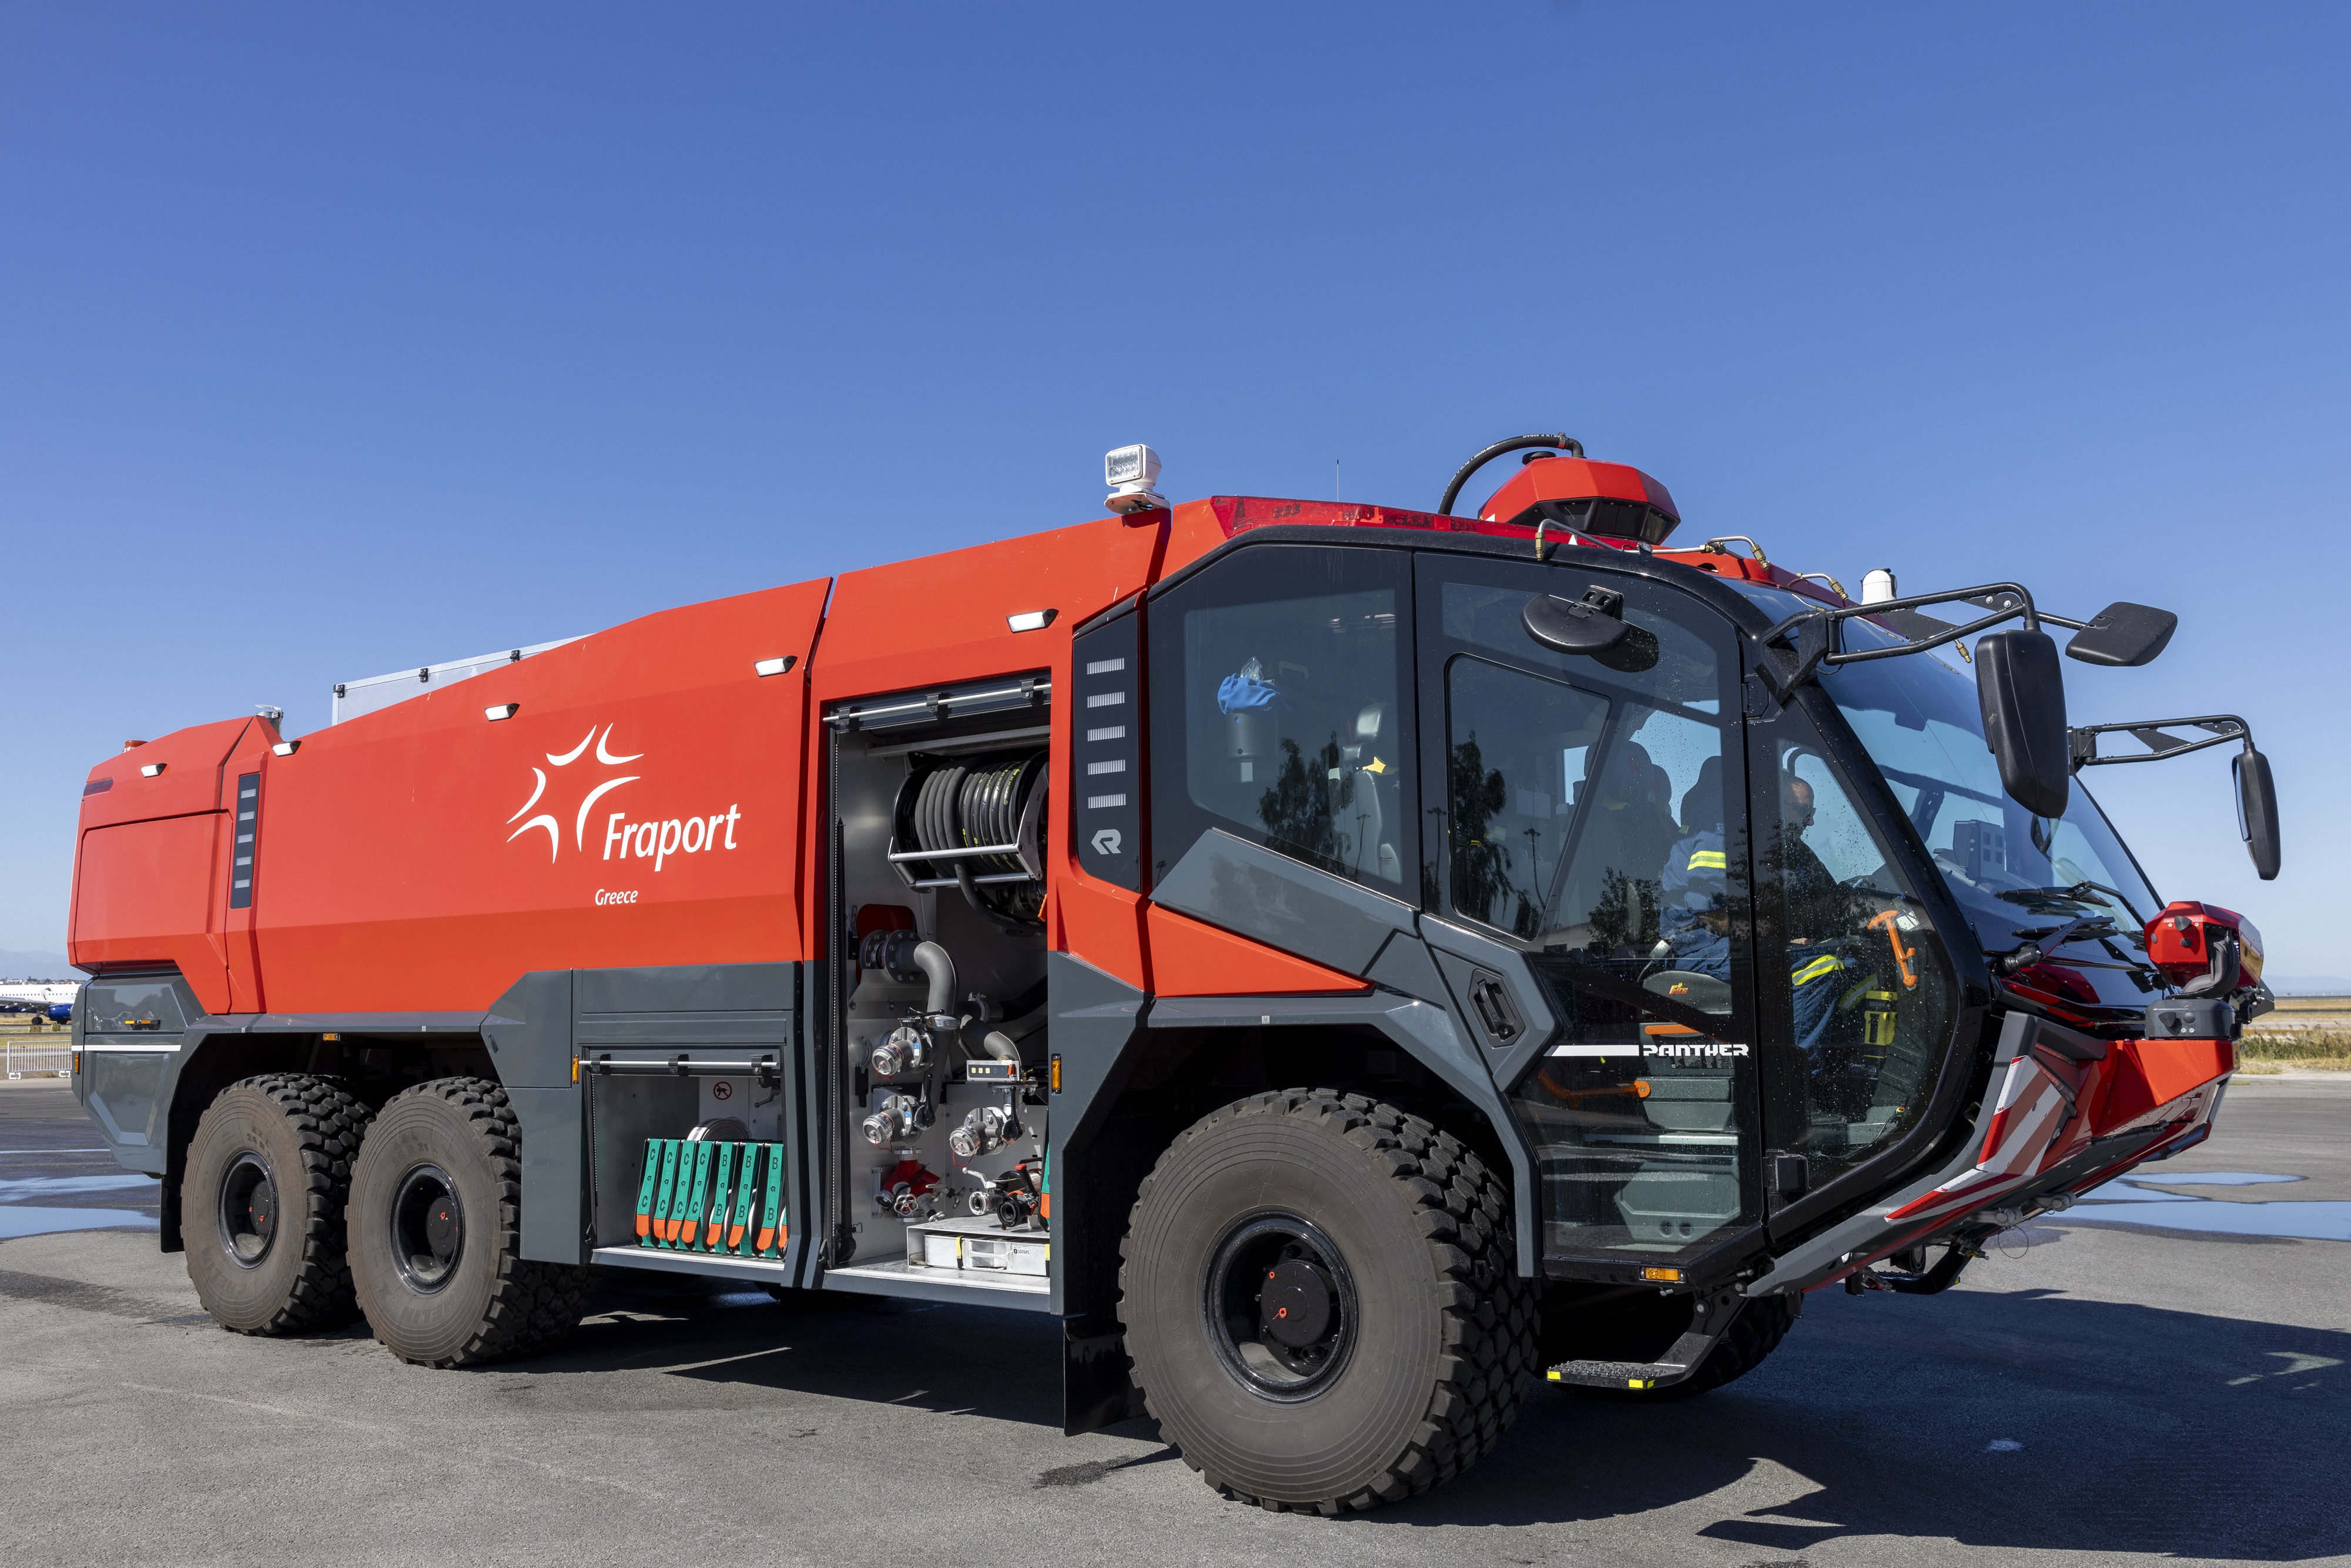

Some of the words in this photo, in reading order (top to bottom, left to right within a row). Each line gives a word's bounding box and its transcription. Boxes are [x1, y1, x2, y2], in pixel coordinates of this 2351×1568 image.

[603, 803, 741, 872] Fraport
[595, 889, 638, 906] Greece
[1643, 1044, 1749, 1057] PANTHER
[650, 1148, 655, 1161] C
[667, 1152, 672, 1164] C
[684, 1153, 689, 1165] C
[700, 1153, 705, 1165] C
[722, 1154, 728, 1167] B
[746, 1155, 751, 1168] B
[772, 1157, 778, 1170] B
[642, 1195, 648, 1207] C
[660, 1200, 665, 1211] C
[677, 1201, 683, 1213] C
[692, 1201, 698, 1213] C
[716, 1204, 722, 1216] B
[739, 1205, 745, 1218] B
[768, 1208, 774, 1220] B
